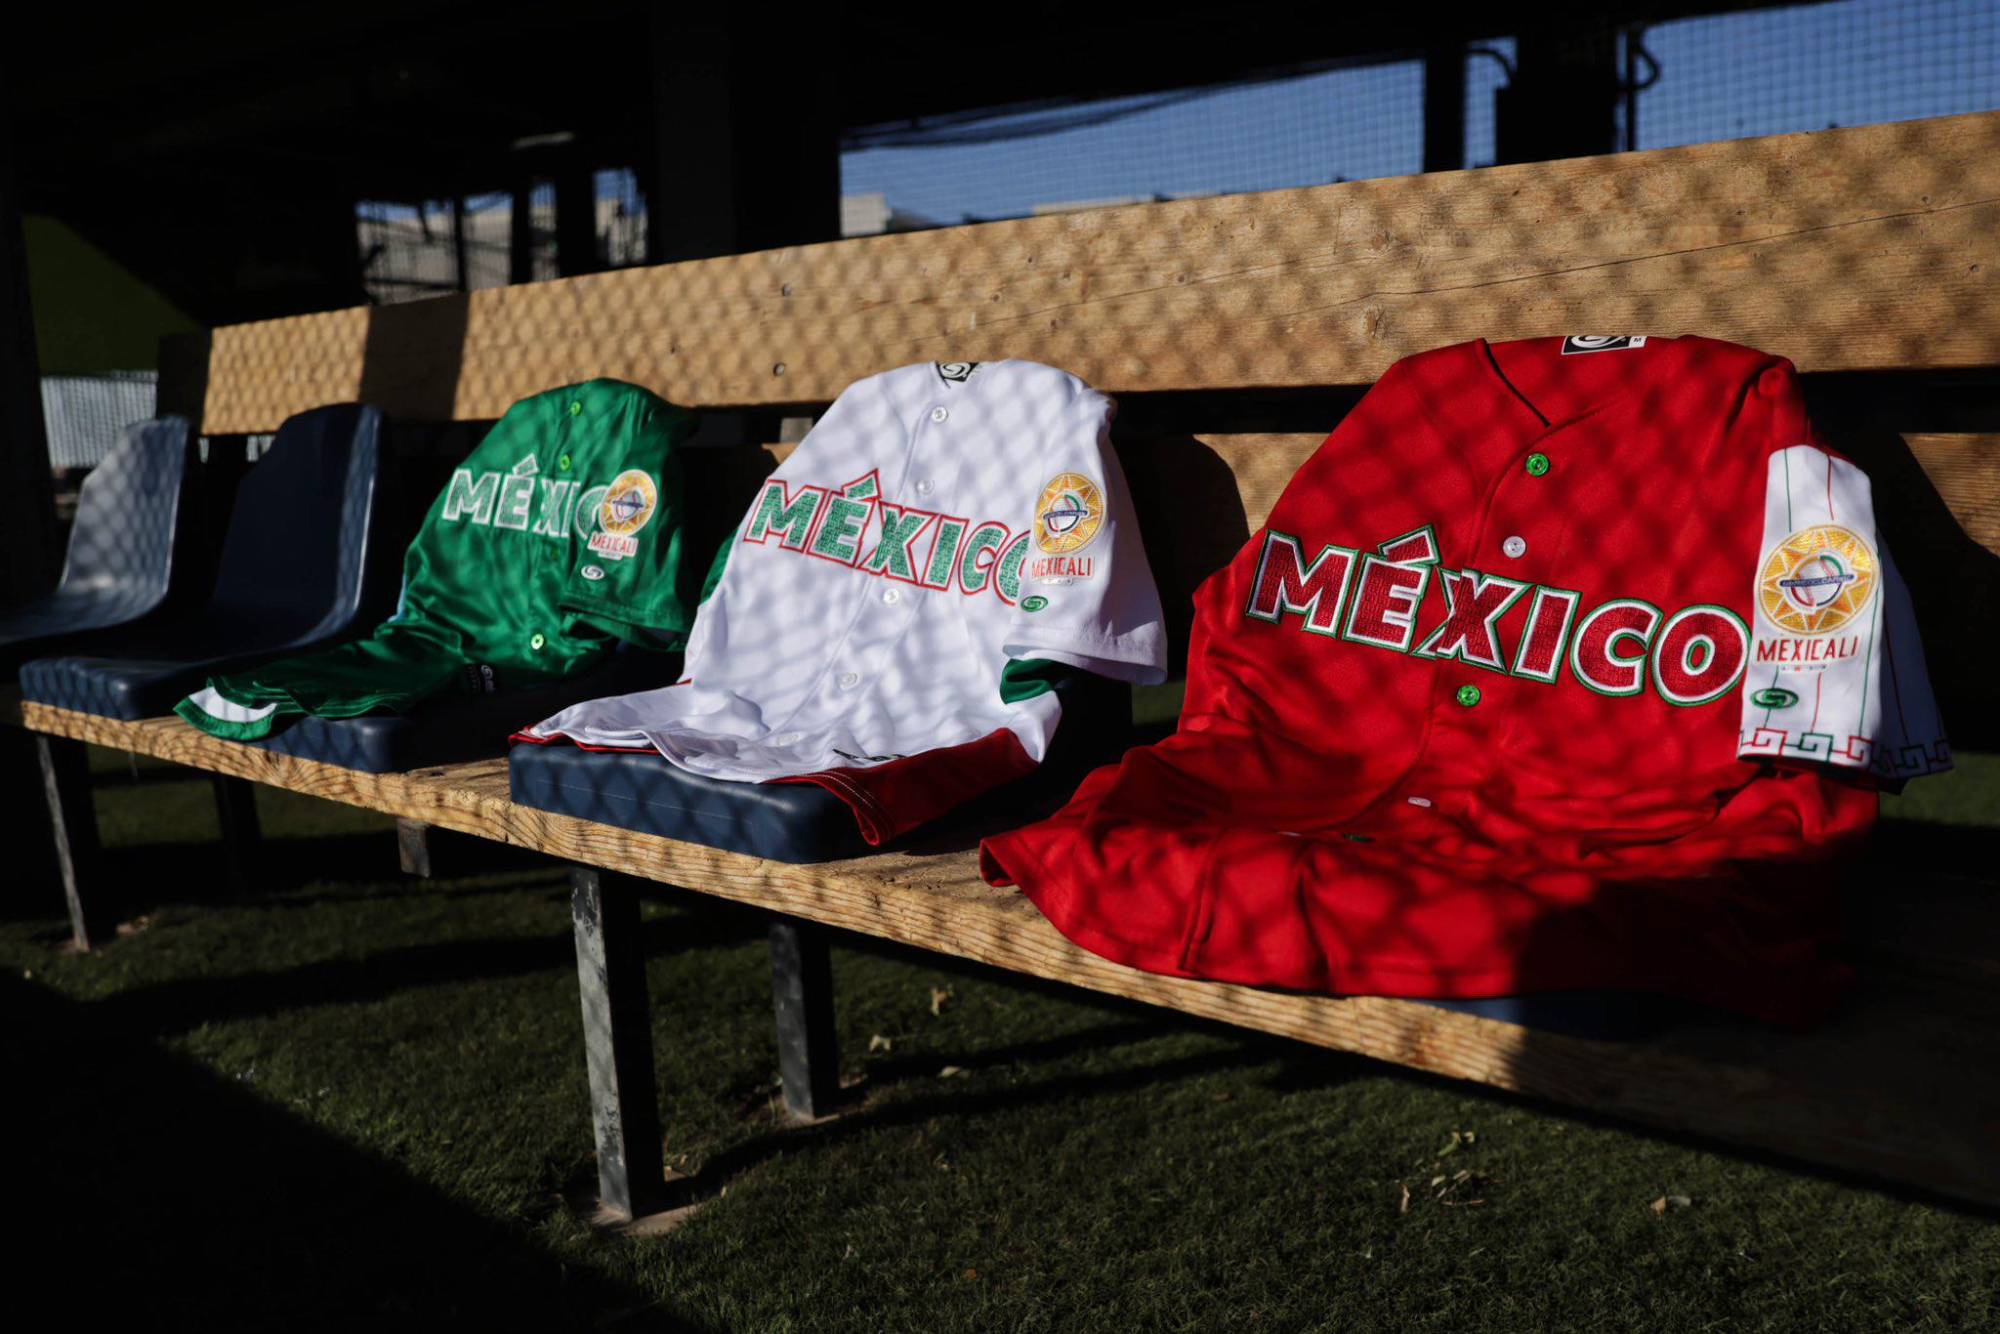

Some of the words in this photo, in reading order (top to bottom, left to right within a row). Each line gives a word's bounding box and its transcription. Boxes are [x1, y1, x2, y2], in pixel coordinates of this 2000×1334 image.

[1031, 556, 1092, 577] MEXICALI
[1246, 523, 1753, 707] MÉXICO
[1757, 636, 1858, 661] MEXICALI
